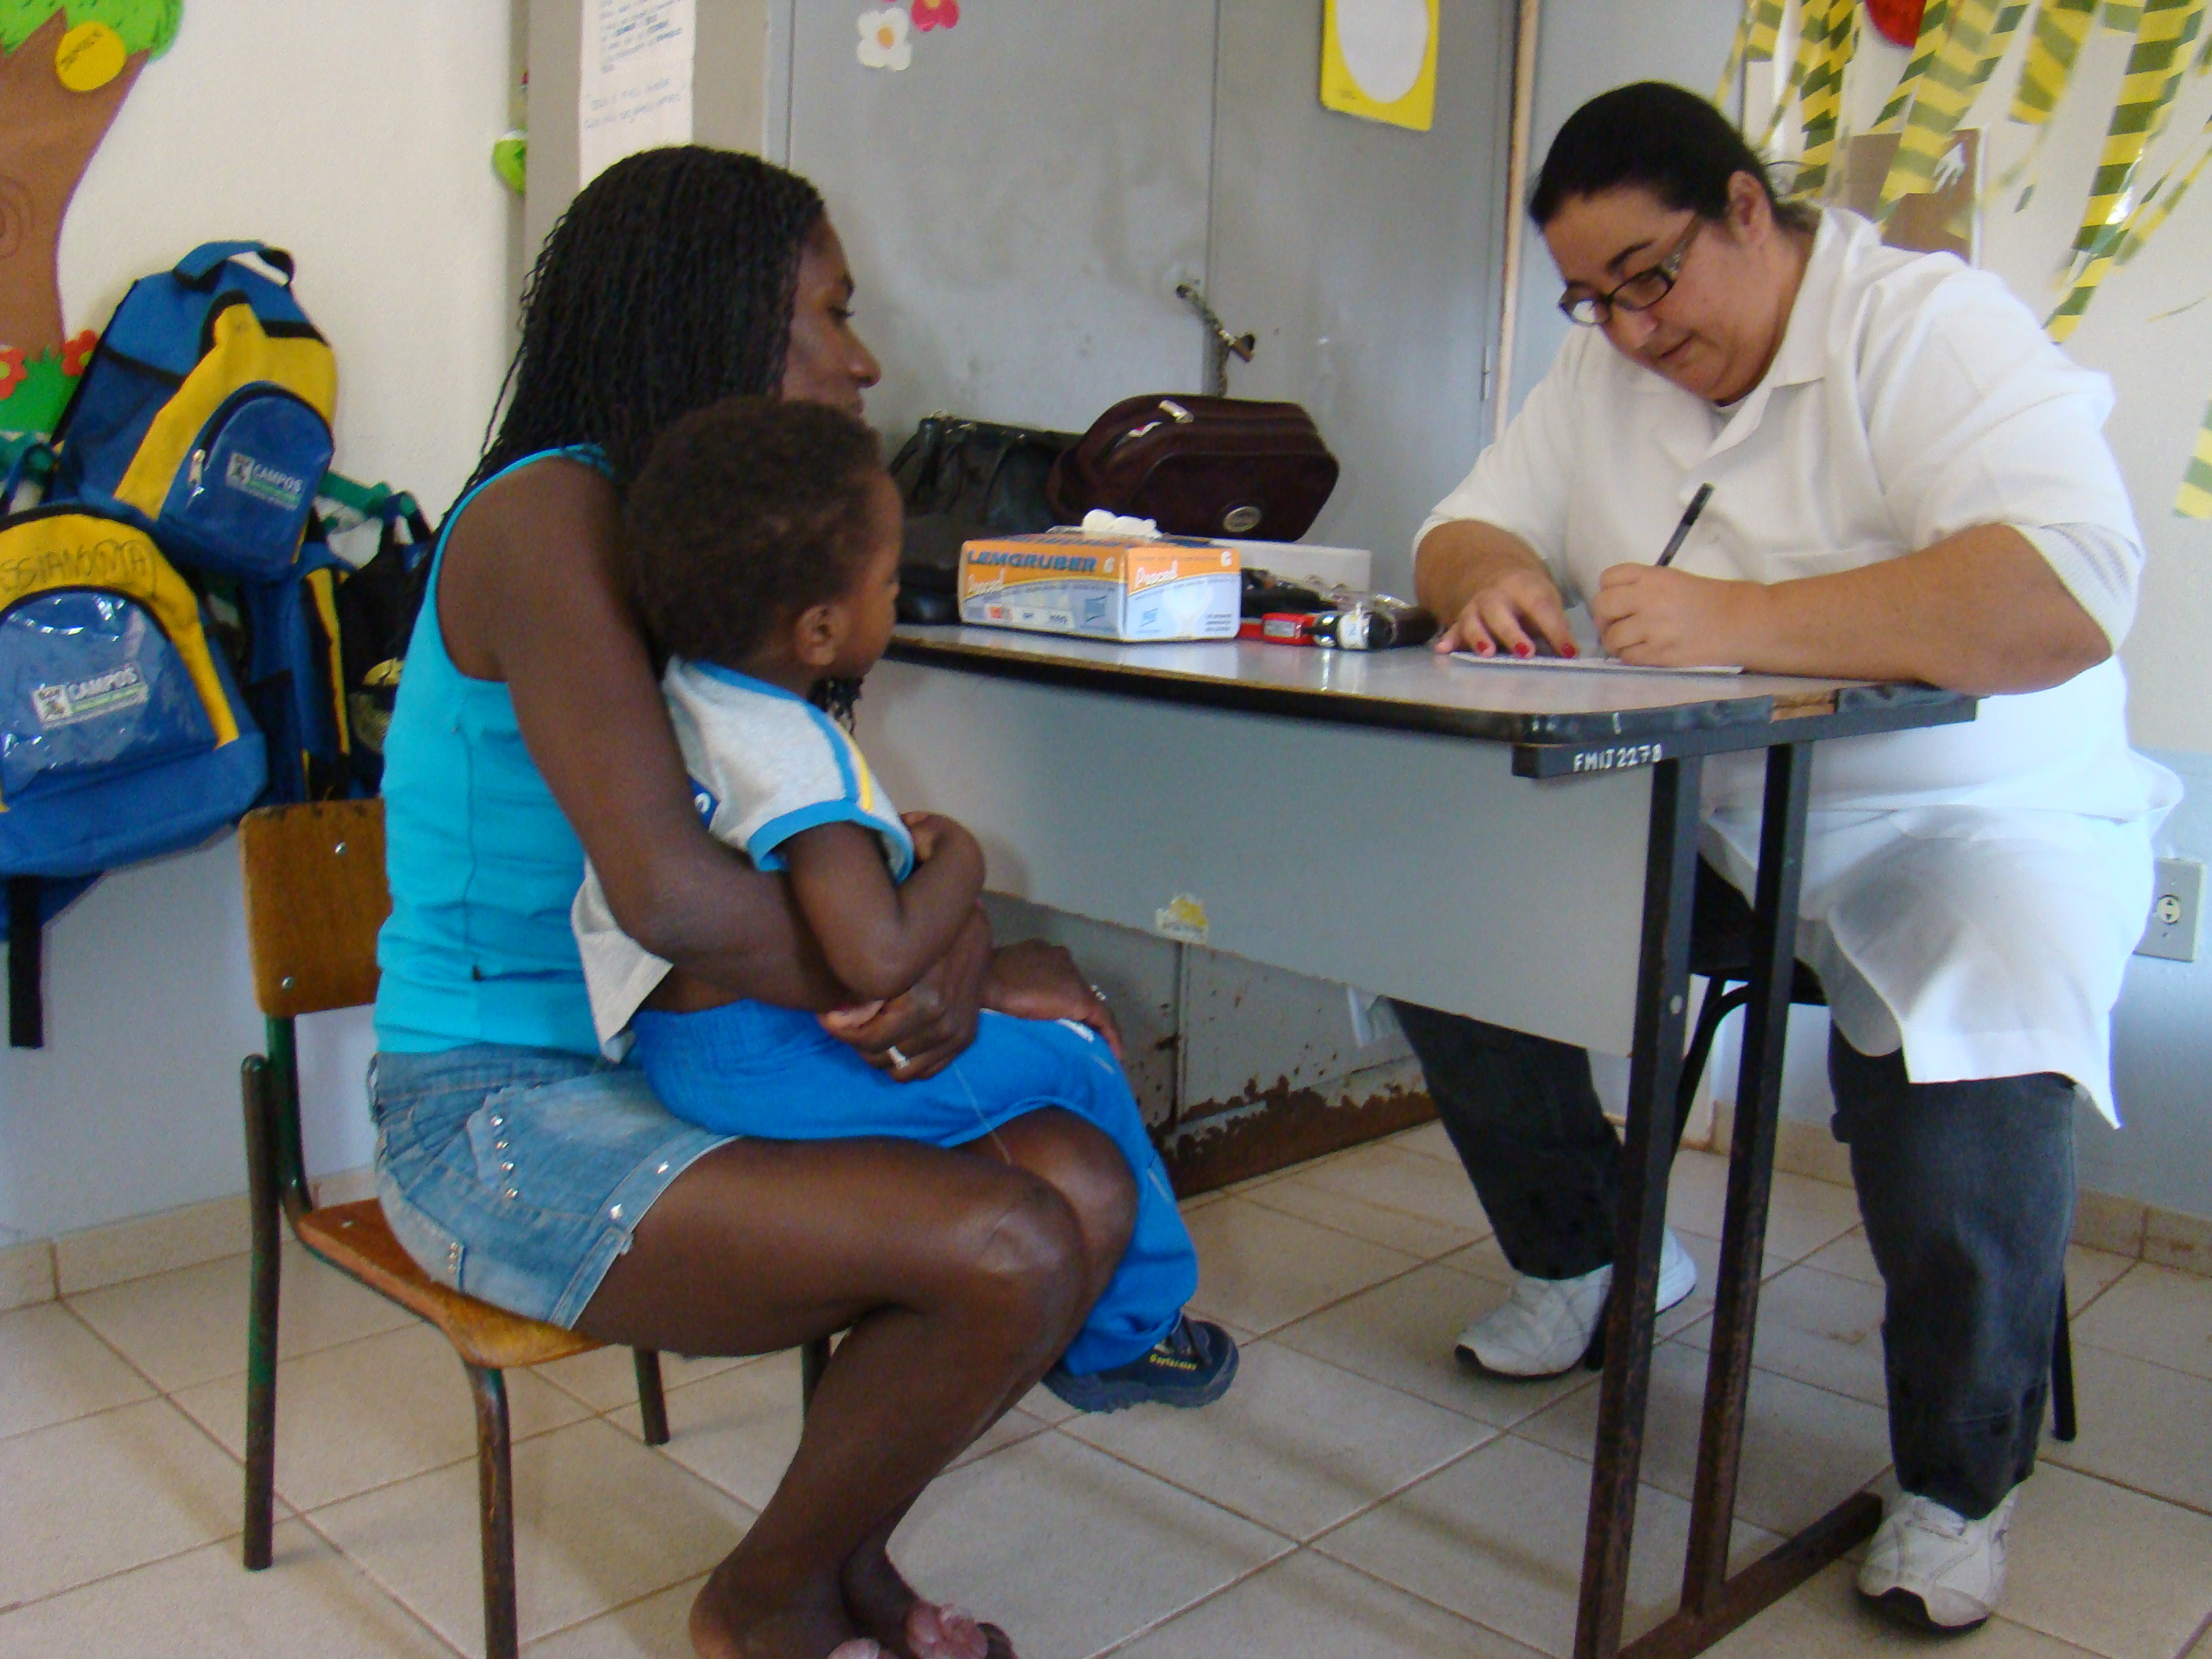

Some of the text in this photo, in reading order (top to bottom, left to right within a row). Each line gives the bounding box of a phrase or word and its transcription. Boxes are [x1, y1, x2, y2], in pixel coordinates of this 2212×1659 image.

[968, 550, 1097, 572] LEMGRUBER
[1221, 550, 1232, 567] G
[68, 667, 138, 700] CAMPOS
